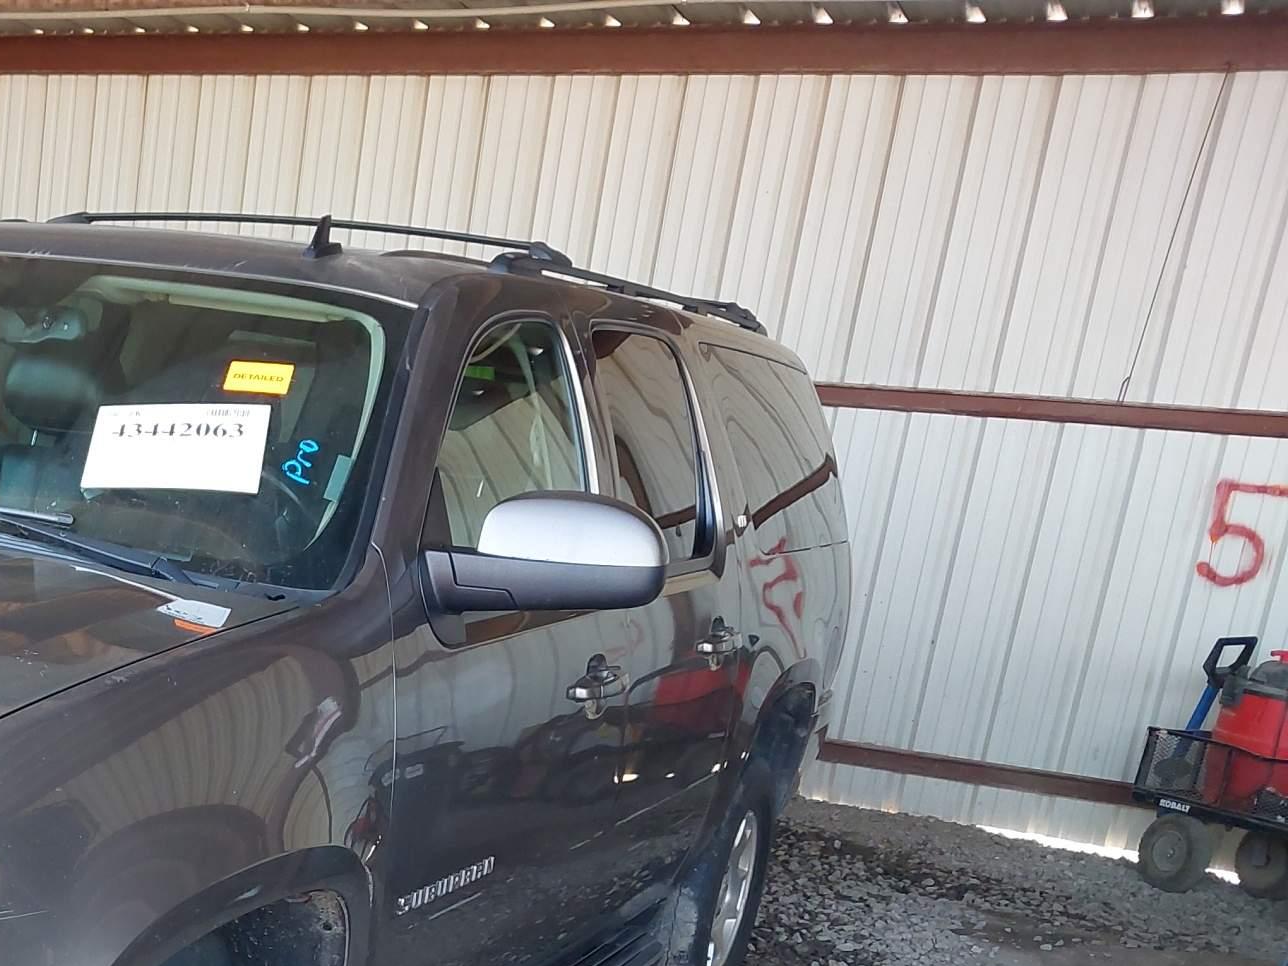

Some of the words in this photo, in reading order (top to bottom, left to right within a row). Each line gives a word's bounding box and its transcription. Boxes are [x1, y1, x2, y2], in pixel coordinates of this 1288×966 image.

[232, 373, 285, 382] DETAILED
[112, 422, 244, 438] 43442063
[1195, 478, 1288, 587] 5
[1159, 798, 1192, 813] KOBALT
[396, 856, 495, 916] SUBURBAN
